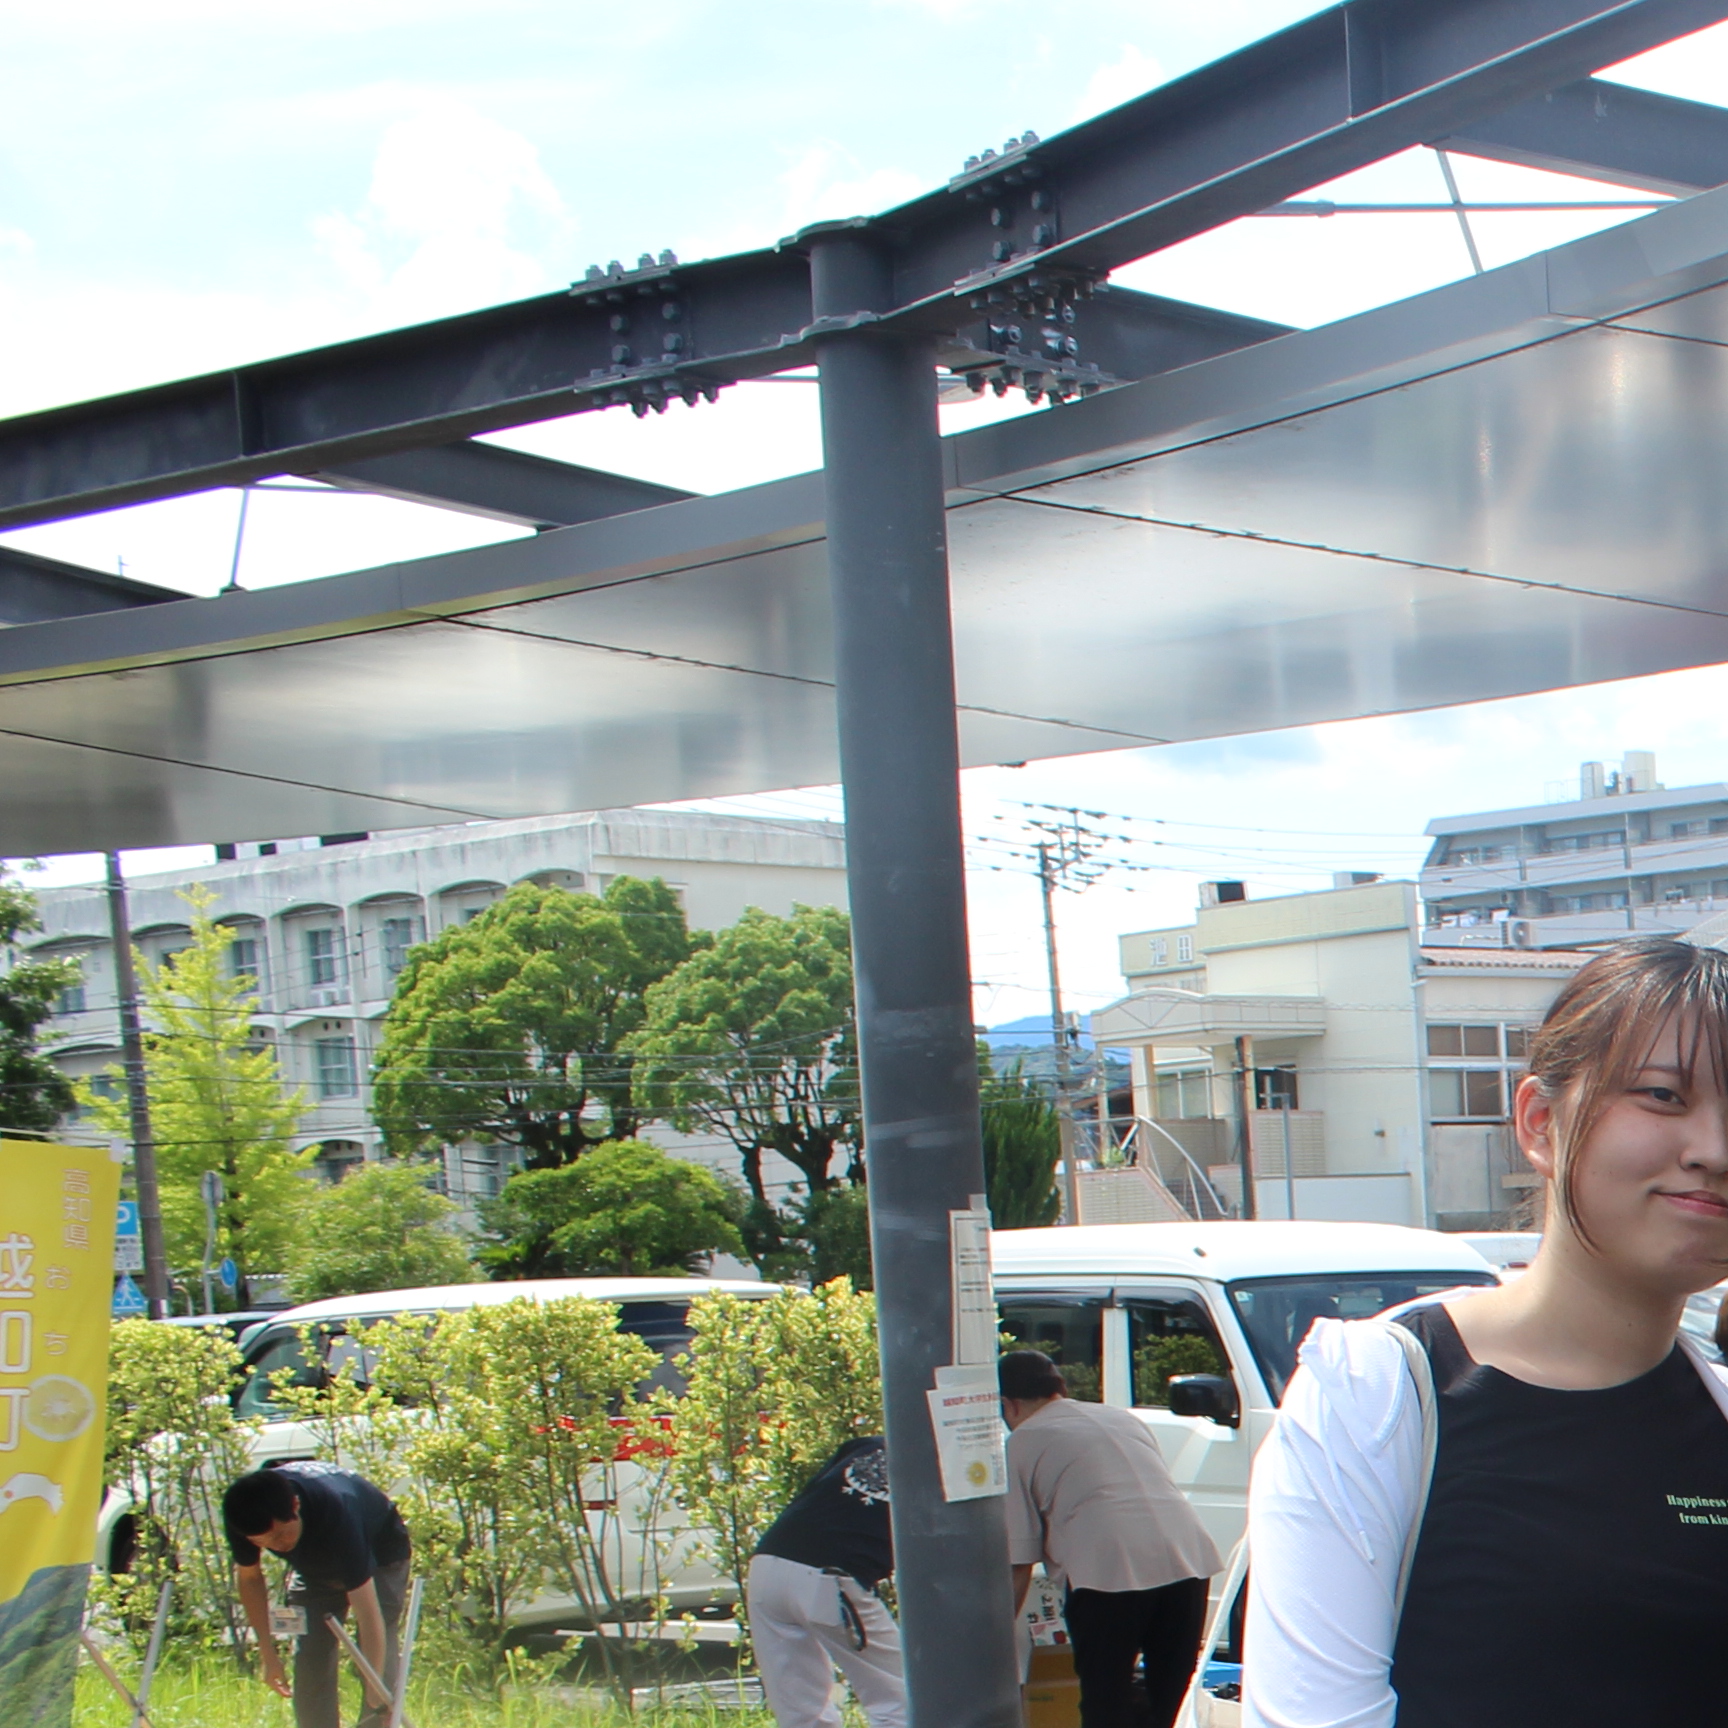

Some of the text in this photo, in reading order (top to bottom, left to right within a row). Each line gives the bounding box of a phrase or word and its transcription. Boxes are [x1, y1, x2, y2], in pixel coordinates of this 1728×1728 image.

[62, 1168, 92, 1251] 高知県
[1666, 1494, 1727, 1509] Happiness
[1679, 1512, 1709, 1525] from
